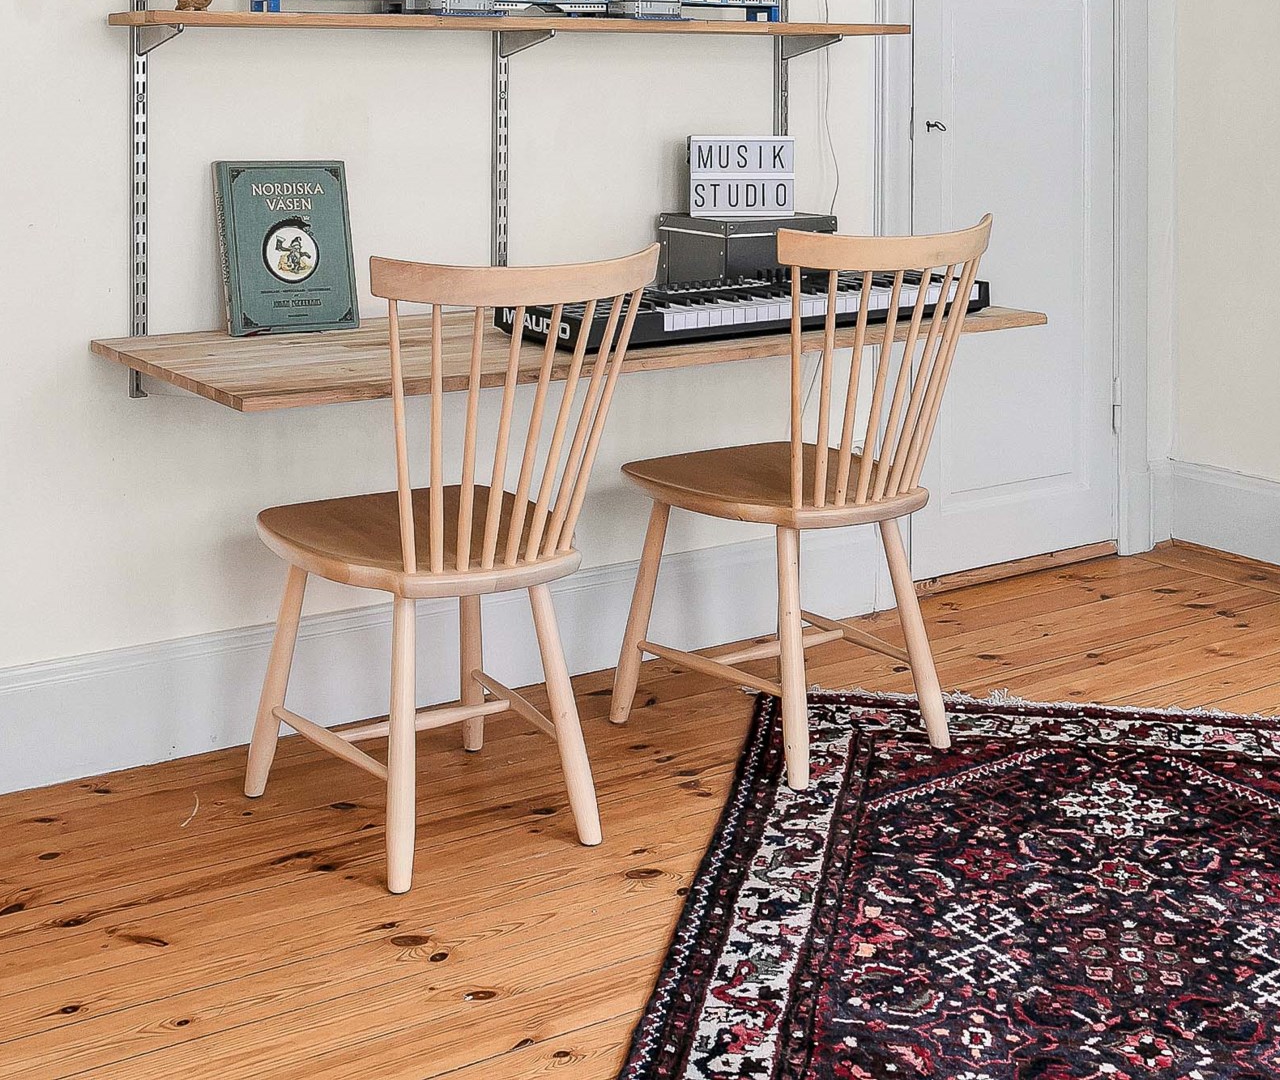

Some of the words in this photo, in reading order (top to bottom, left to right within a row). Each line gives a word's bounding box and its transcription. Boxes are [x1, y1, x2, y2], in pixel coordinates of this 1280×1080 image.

[697, 145, 785, 169] MUSIK
[251, 183, 324, 196] NORDISKA
[694, 183, 787, 208] STUDIO
[266, 197, 312, 211] VÄSEN
